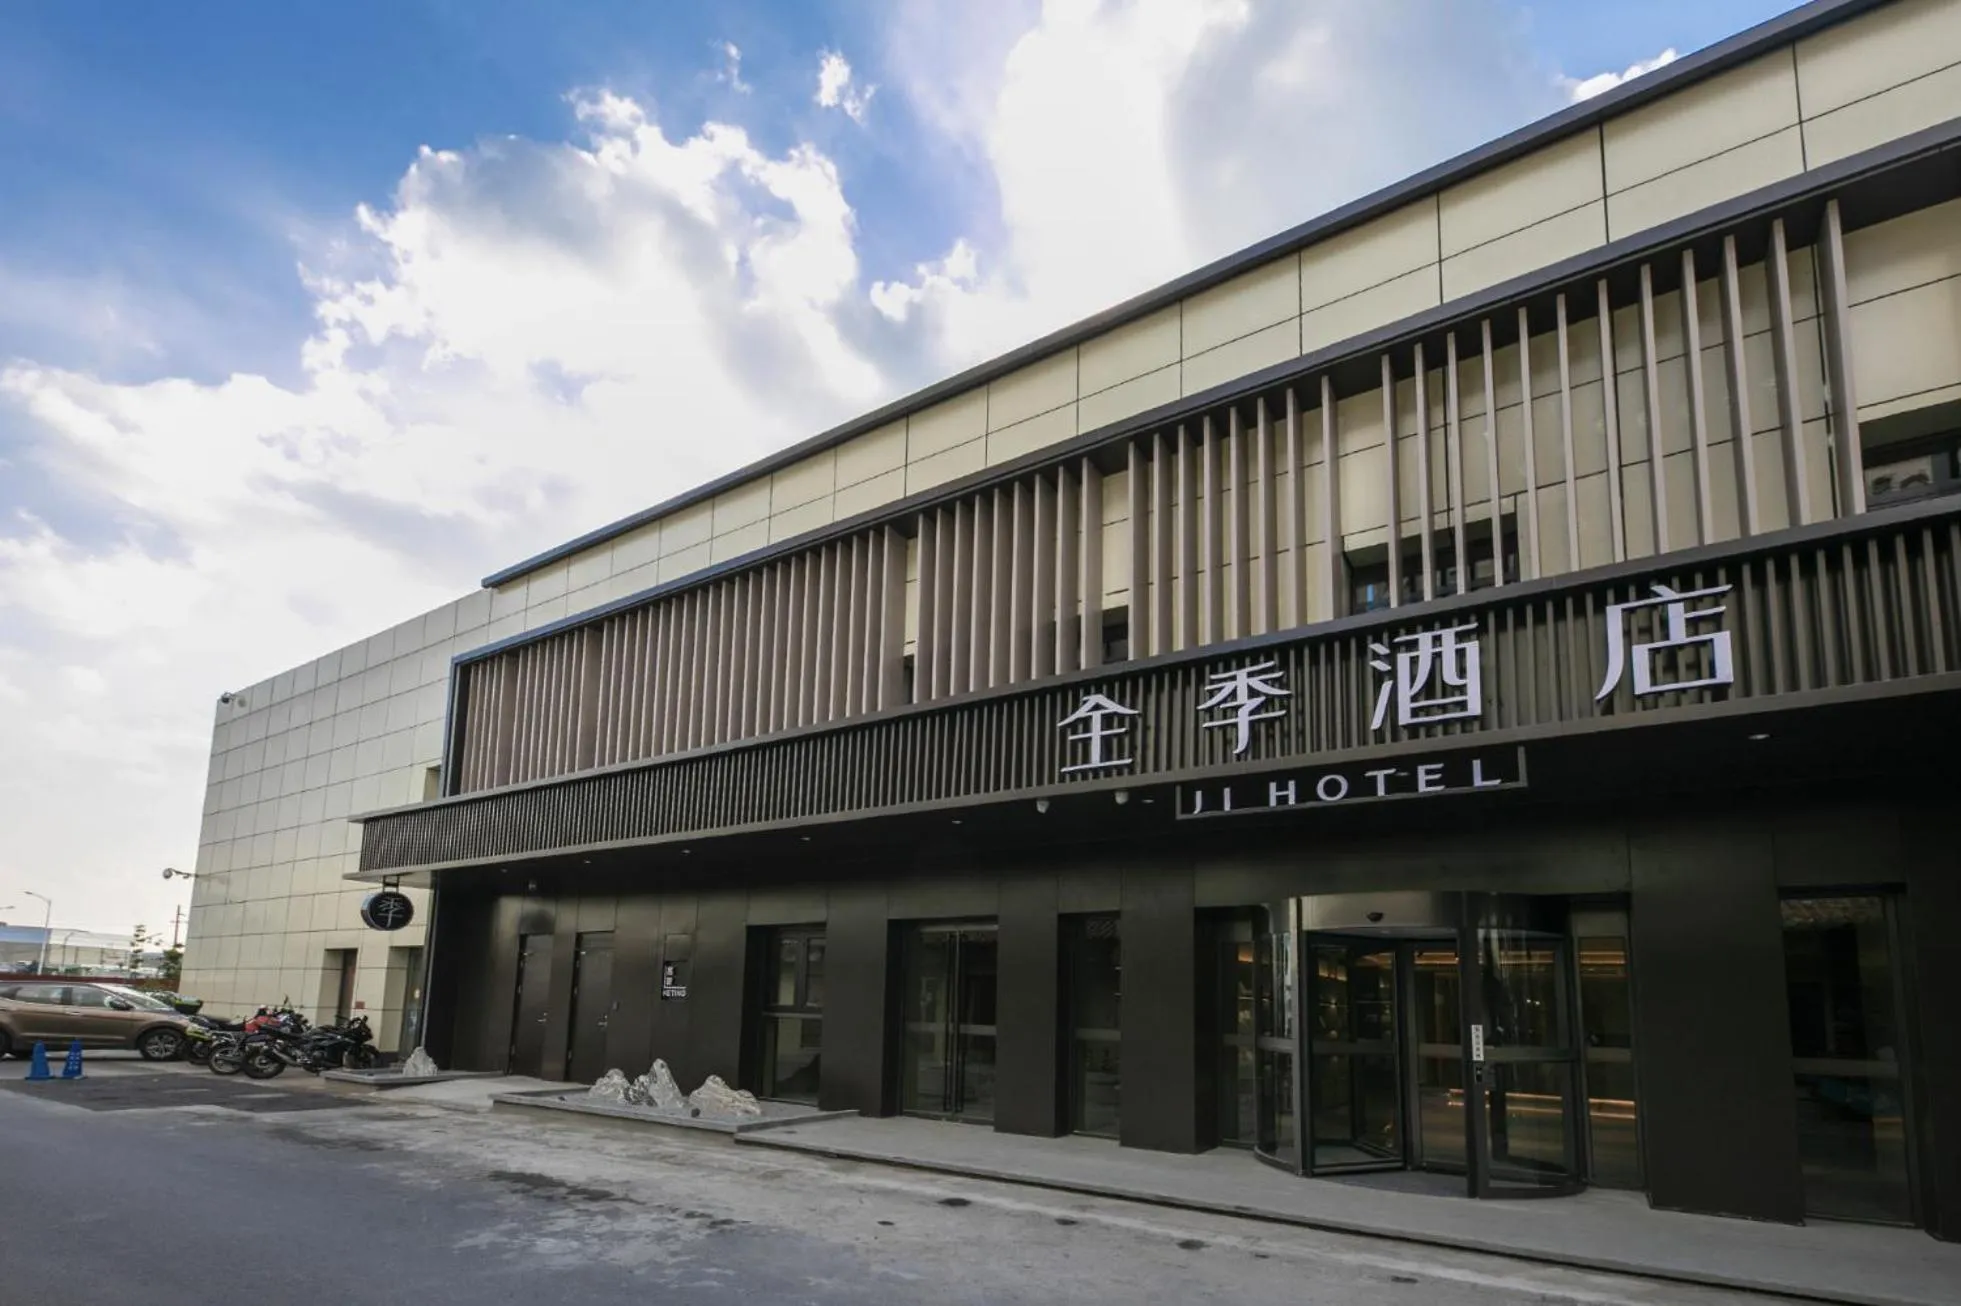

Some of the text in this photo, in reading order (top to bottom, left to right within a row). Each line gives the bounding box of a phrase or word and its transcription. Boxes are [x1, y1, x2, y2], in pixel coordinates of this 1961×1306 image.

[1058, 584, 1735, 772] 全季酒店
[1192, 759, 1502, 815] JI HOTEL
[378, 896, 405, 928] 季
